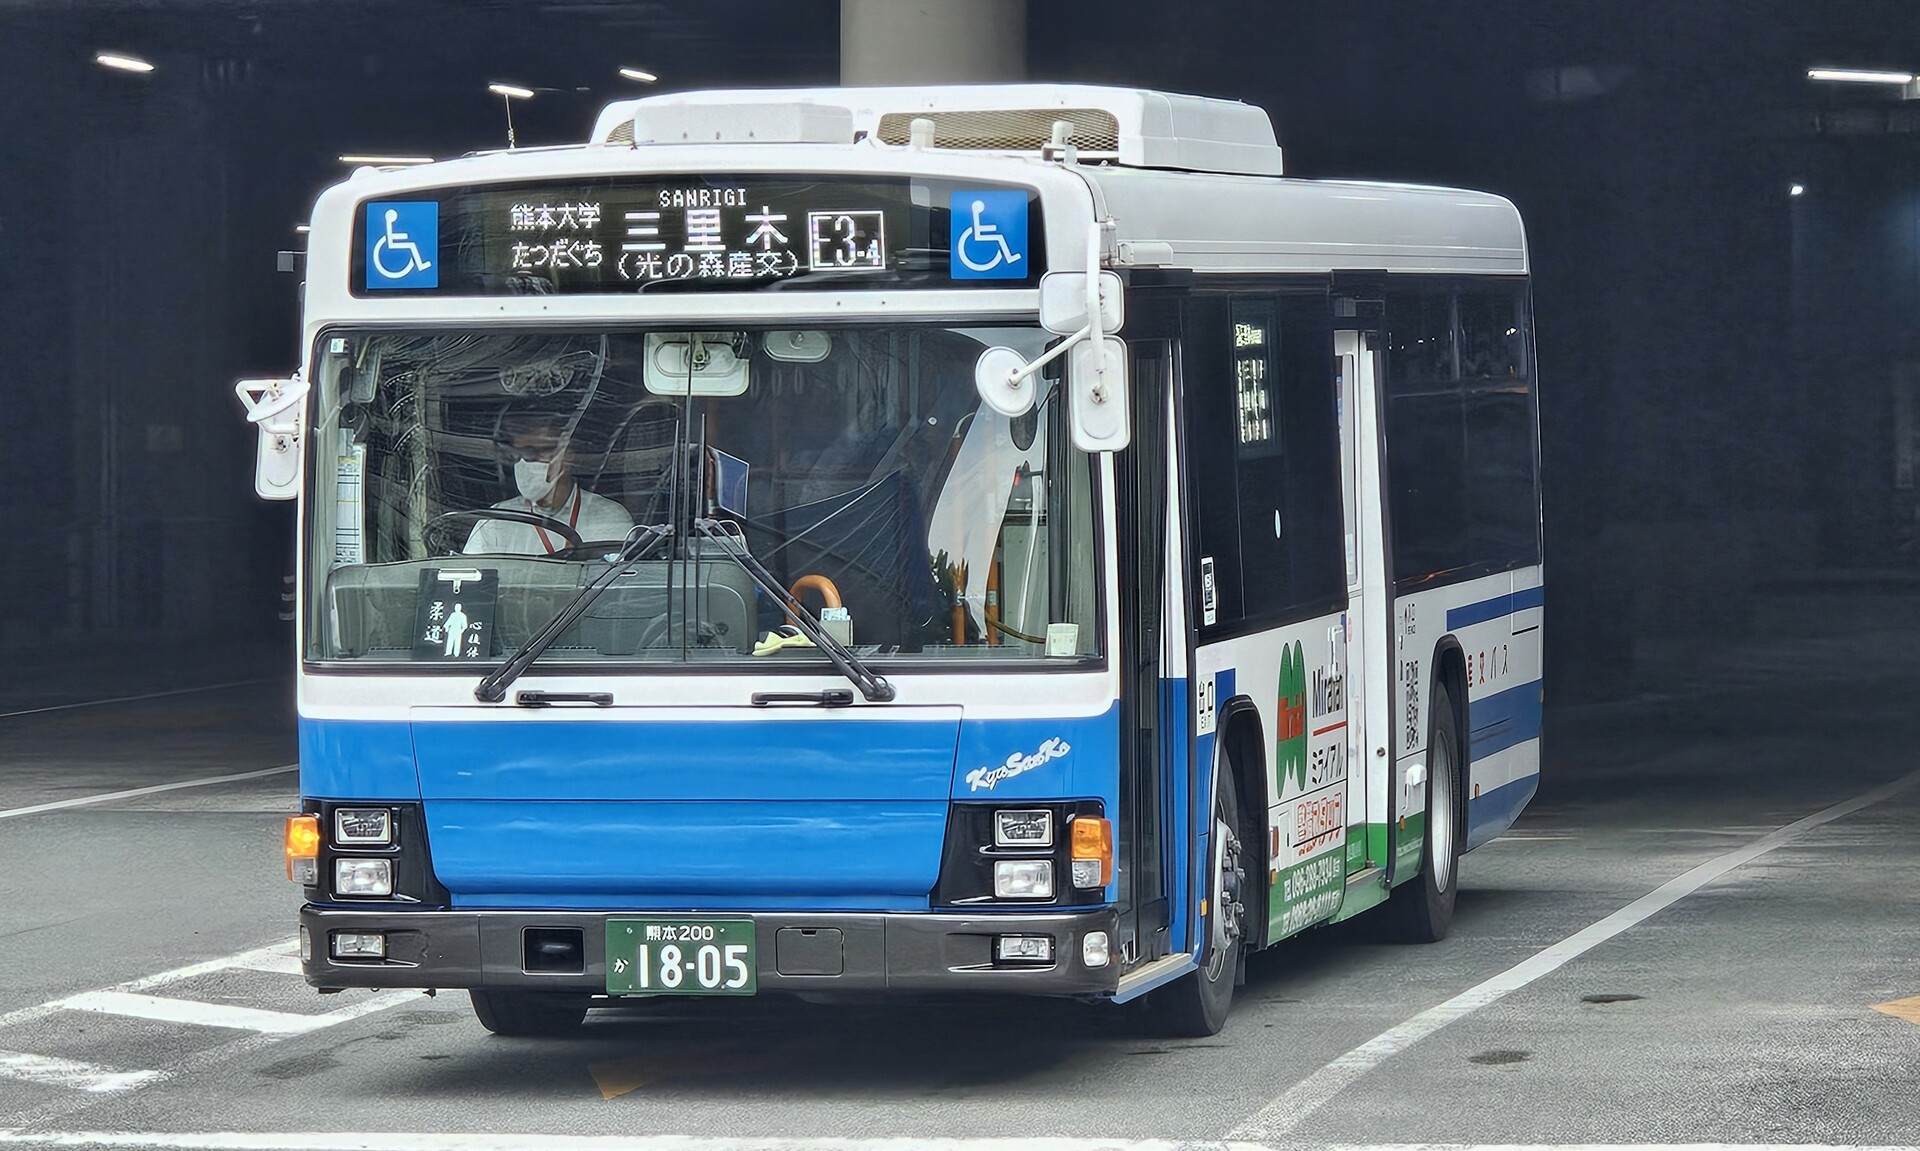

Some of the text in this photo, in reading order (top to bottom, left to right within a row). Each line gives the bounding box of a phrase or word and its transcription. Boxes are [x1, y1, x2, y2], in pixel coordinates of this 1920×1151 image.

[510, 202, 600, 230] 熊本大学
[659, 189, 747, 207] SANRIGI
[621, 205, 789, 251] 三里木
[511, 239, 603, 268] たつだぐち
[424, 601, 444, 644] 柔道
[1311, 742, 1344, 784] ミライアル
[613, 944, 748, 989] か 18-05
